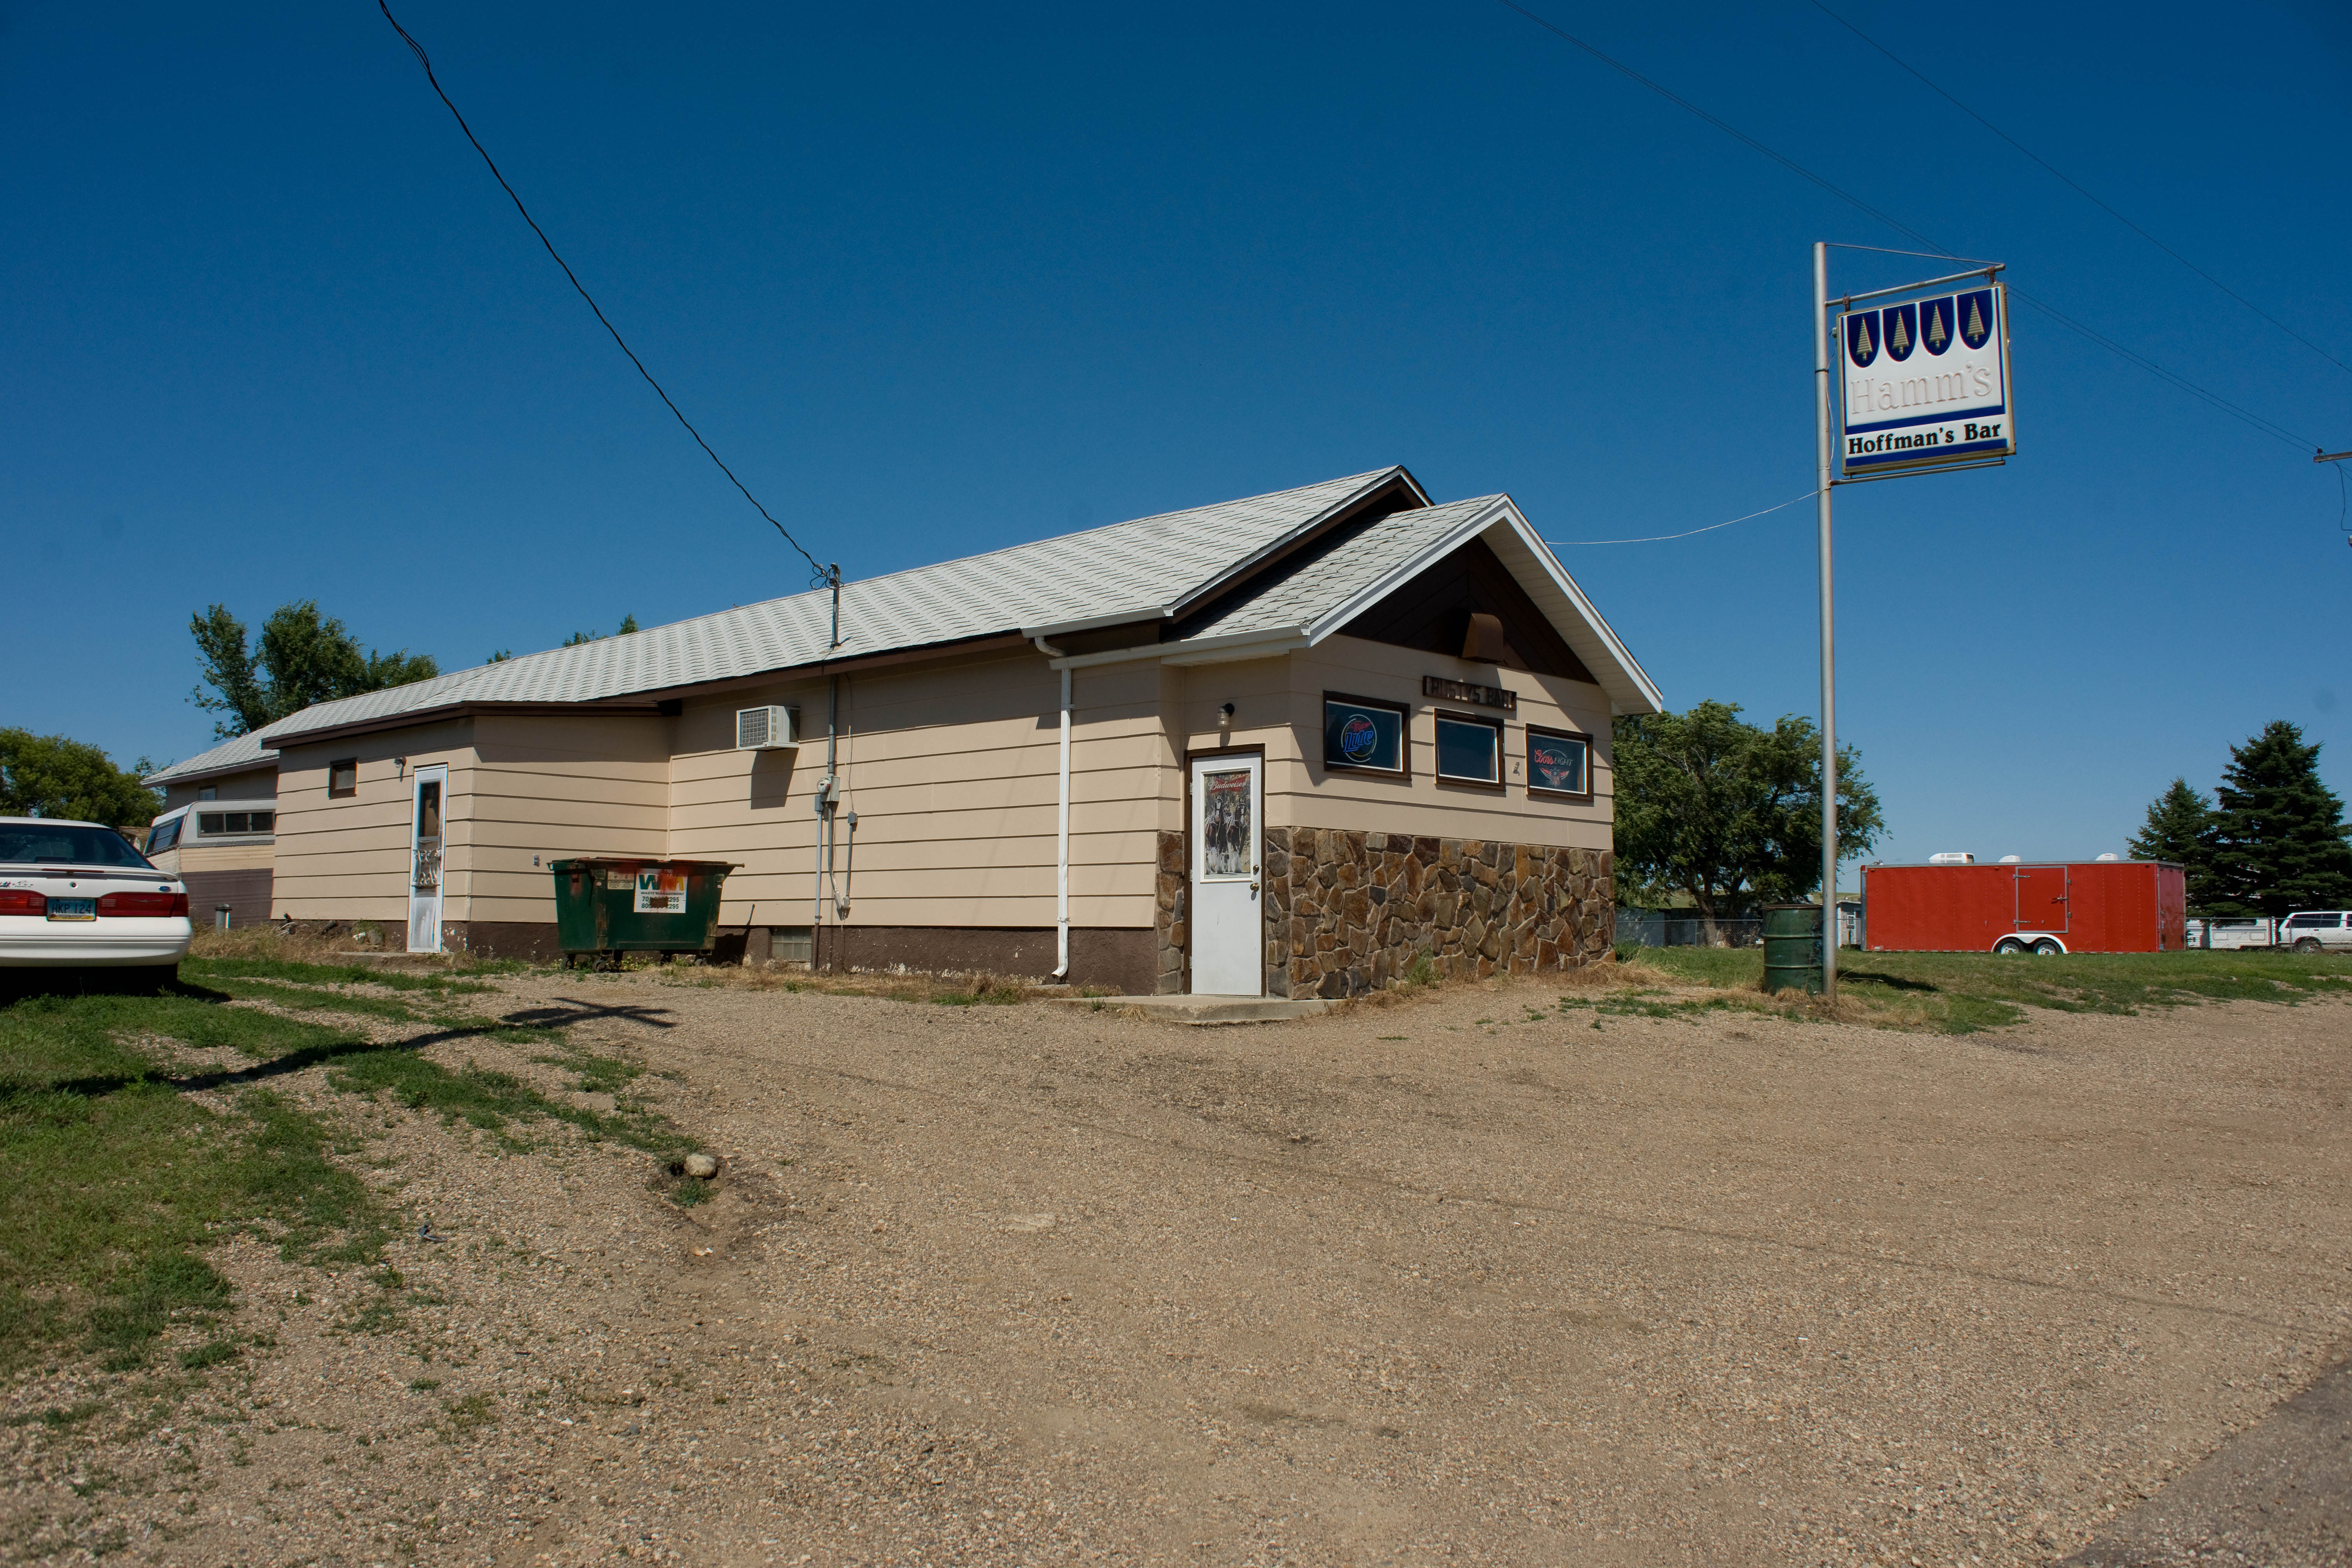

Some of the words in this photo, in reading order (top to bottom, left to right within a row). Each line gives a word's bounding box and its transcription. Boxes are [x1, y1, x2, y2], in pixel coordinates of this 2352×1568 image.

[1850, 360, 1992, 415] Hamm's
[1848, 427, 1955, 455] Hoffman's
[1964, 423, 2002, 441] Bar
[1343, 730, 1374, 753] Lite
[1534, 749, 1554, 765] Coors
[1554, 757, 1573, 766] LIGHT
[1208, 780, 1246, 791] Budweiser
[52, 904, 70, 914] HKP
[74, 904, 91, 914] 124
